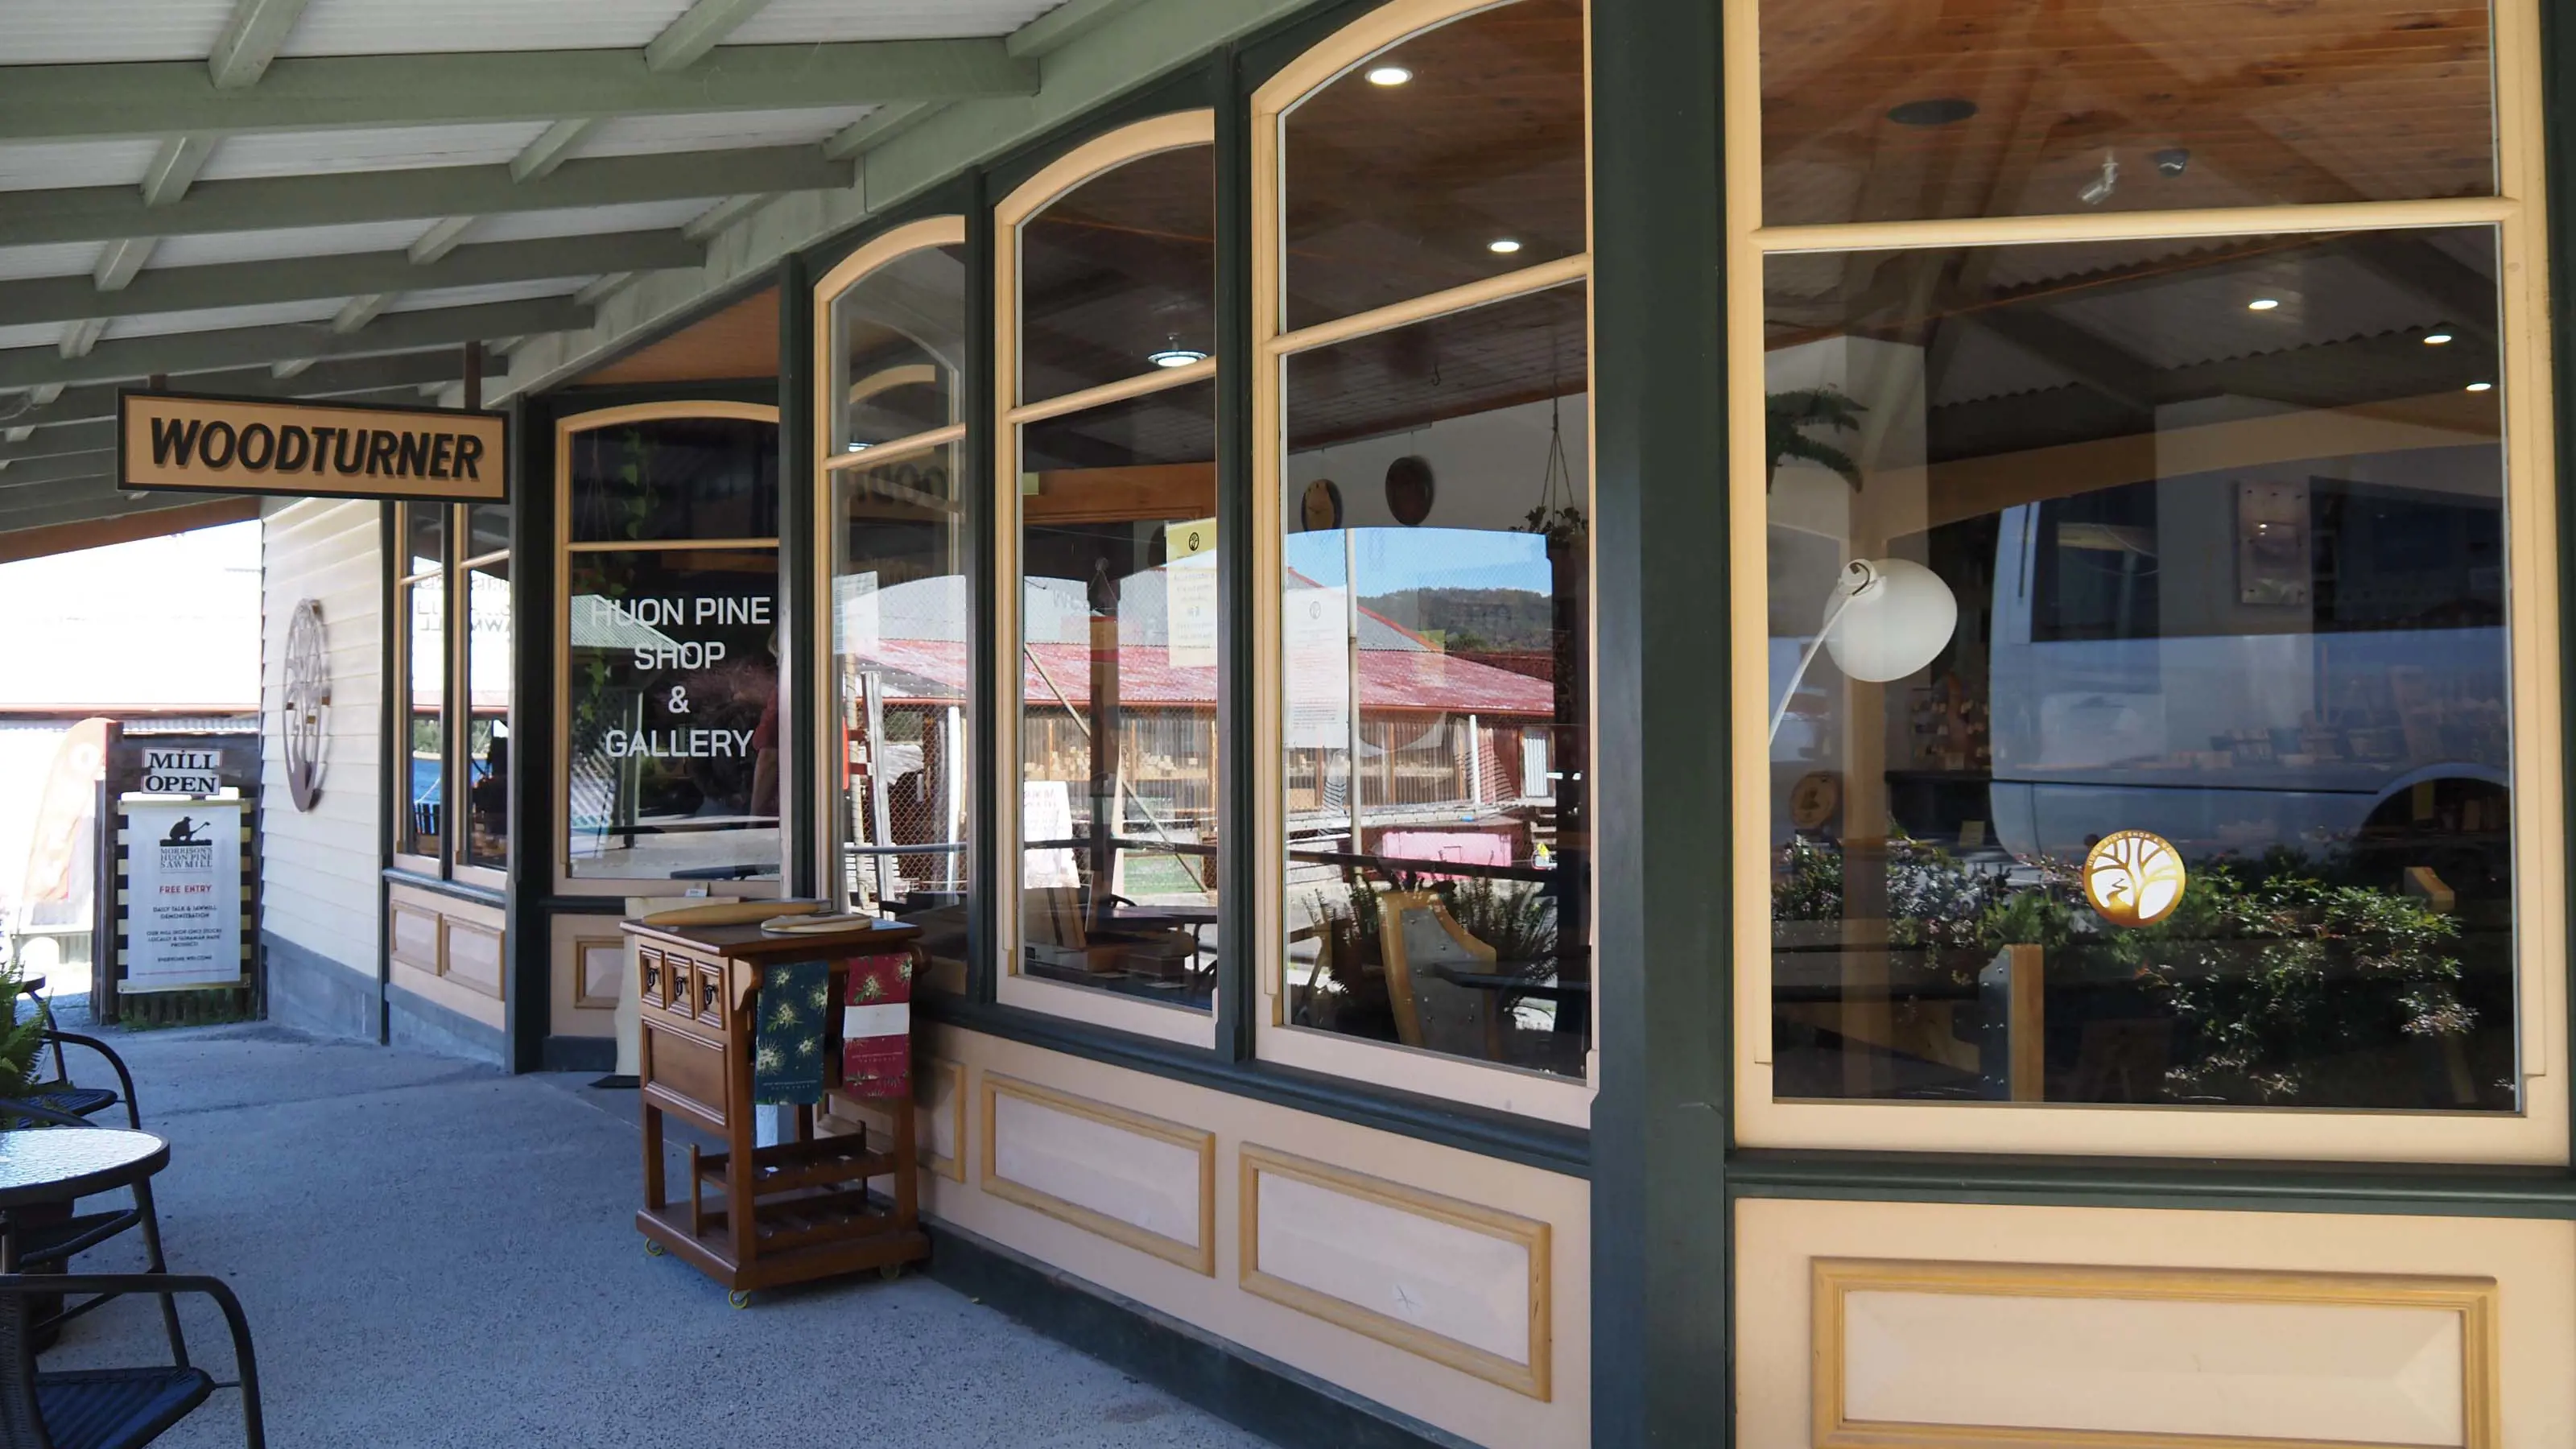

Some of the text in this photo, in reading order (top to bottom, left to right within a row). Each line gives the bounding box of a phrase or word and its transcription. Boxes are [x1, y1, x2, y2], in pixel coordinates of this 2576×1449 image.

[151, 416, 483, 481] WOODTURNER
[591, 597, 770, 625] HUON PINE
[634, 642, 725, 670] SHOP
[668, 686, 690, 712] &
[605, 729, 753, 757] GALLERY
[149, 753, 217, 770] MILL
[146, 775, 217, 792] OPEN
[159, 885, 213, 894] FREE ENTRY
